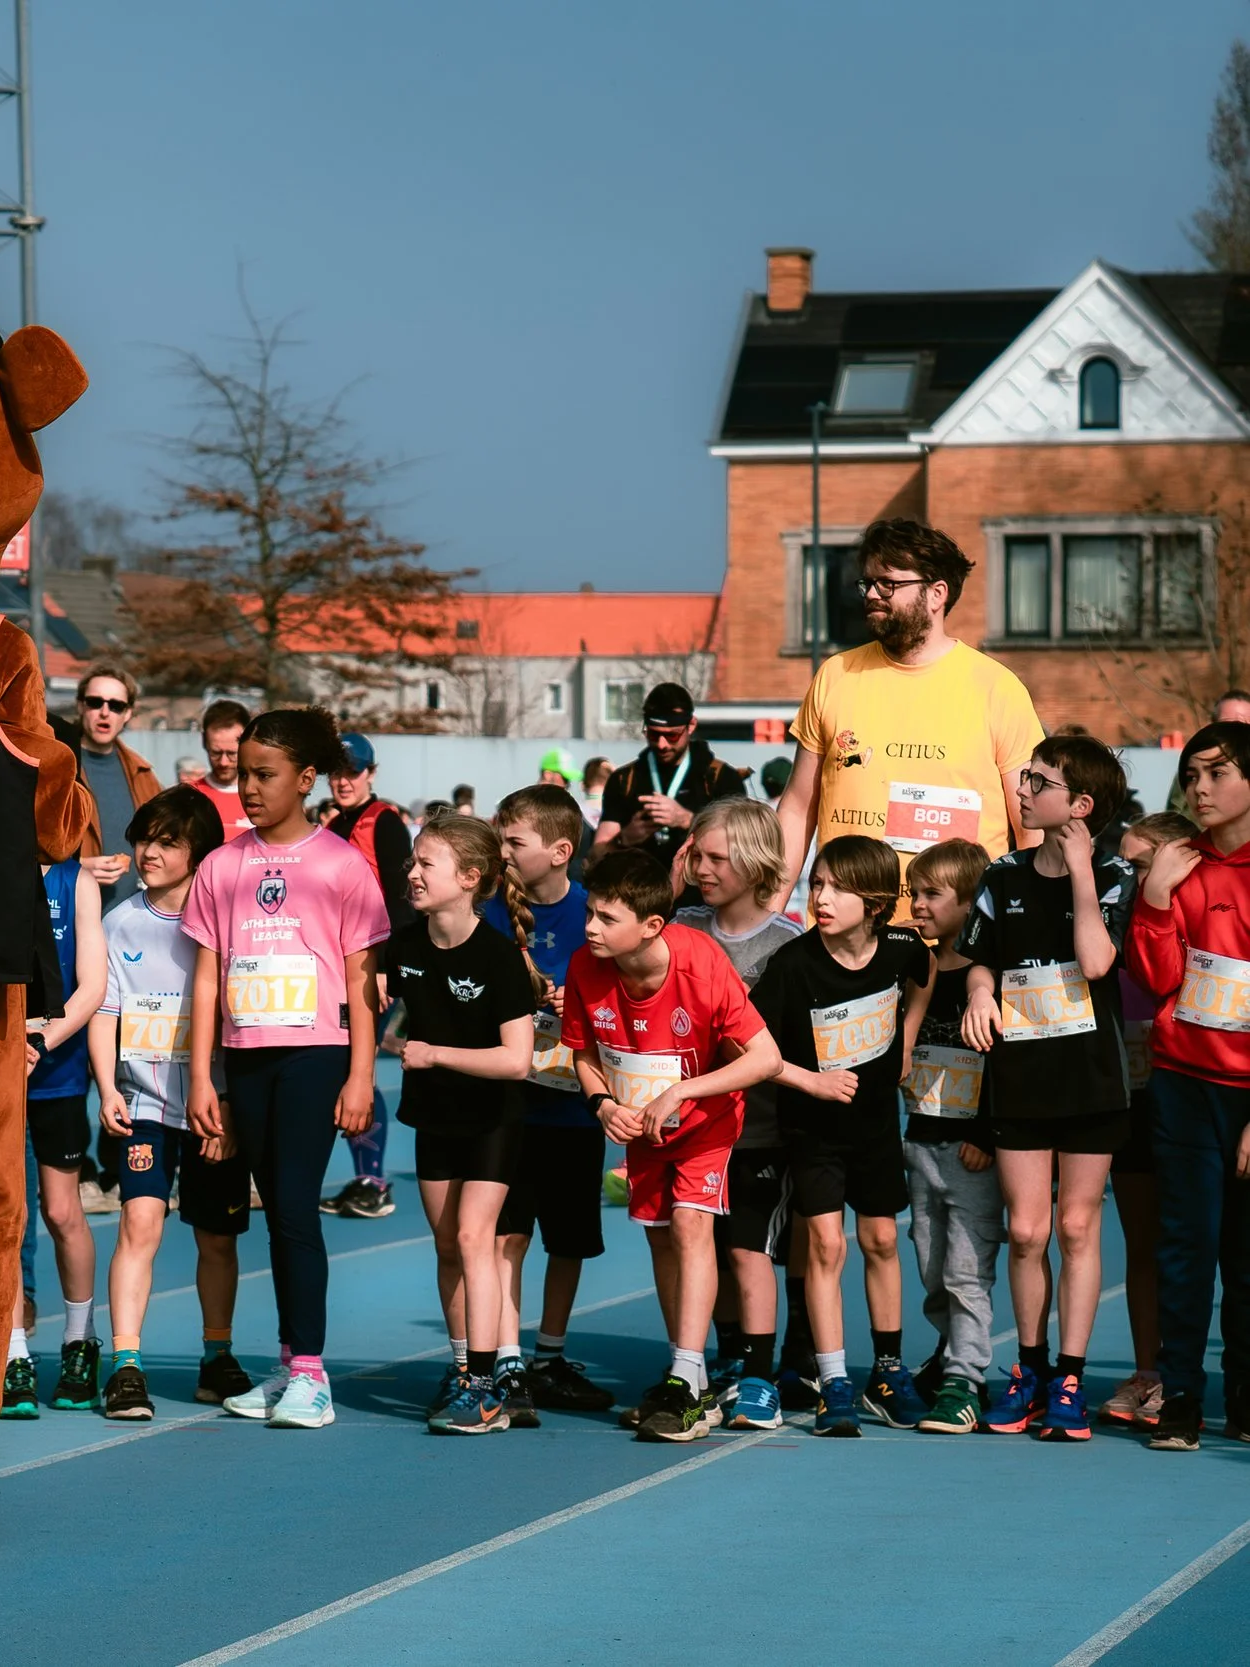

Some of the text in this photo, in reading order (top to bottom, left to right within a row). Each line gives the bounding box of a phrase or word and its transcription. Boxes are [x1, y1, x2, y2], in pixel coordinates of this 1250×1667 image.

[885, 743, 946, 760] CITIUS
[830, 808, 886, 827] ALTIUS
[914, 807, 952, 825] BOB
[922, 828, 939, 839] 275
[252, 930, 294, 942] LEAGUE
[1056, 967, 1079, 980] KIDS
[231, 978, 311, 1010] 7017
[456, 987, 475, 999] KRC
[877, 992, 895, 1007] KIDS
[1180, 972, 1250, 1018] 7013
[1005, 984, 1086, 1025] 7063
[633, 1019, 648, 1032] SK
[820, 1007, 895, 1058] 7003
[650, 1061, 675, 1071] KIDS
[954, 1055, 979, 1066] KIDS
